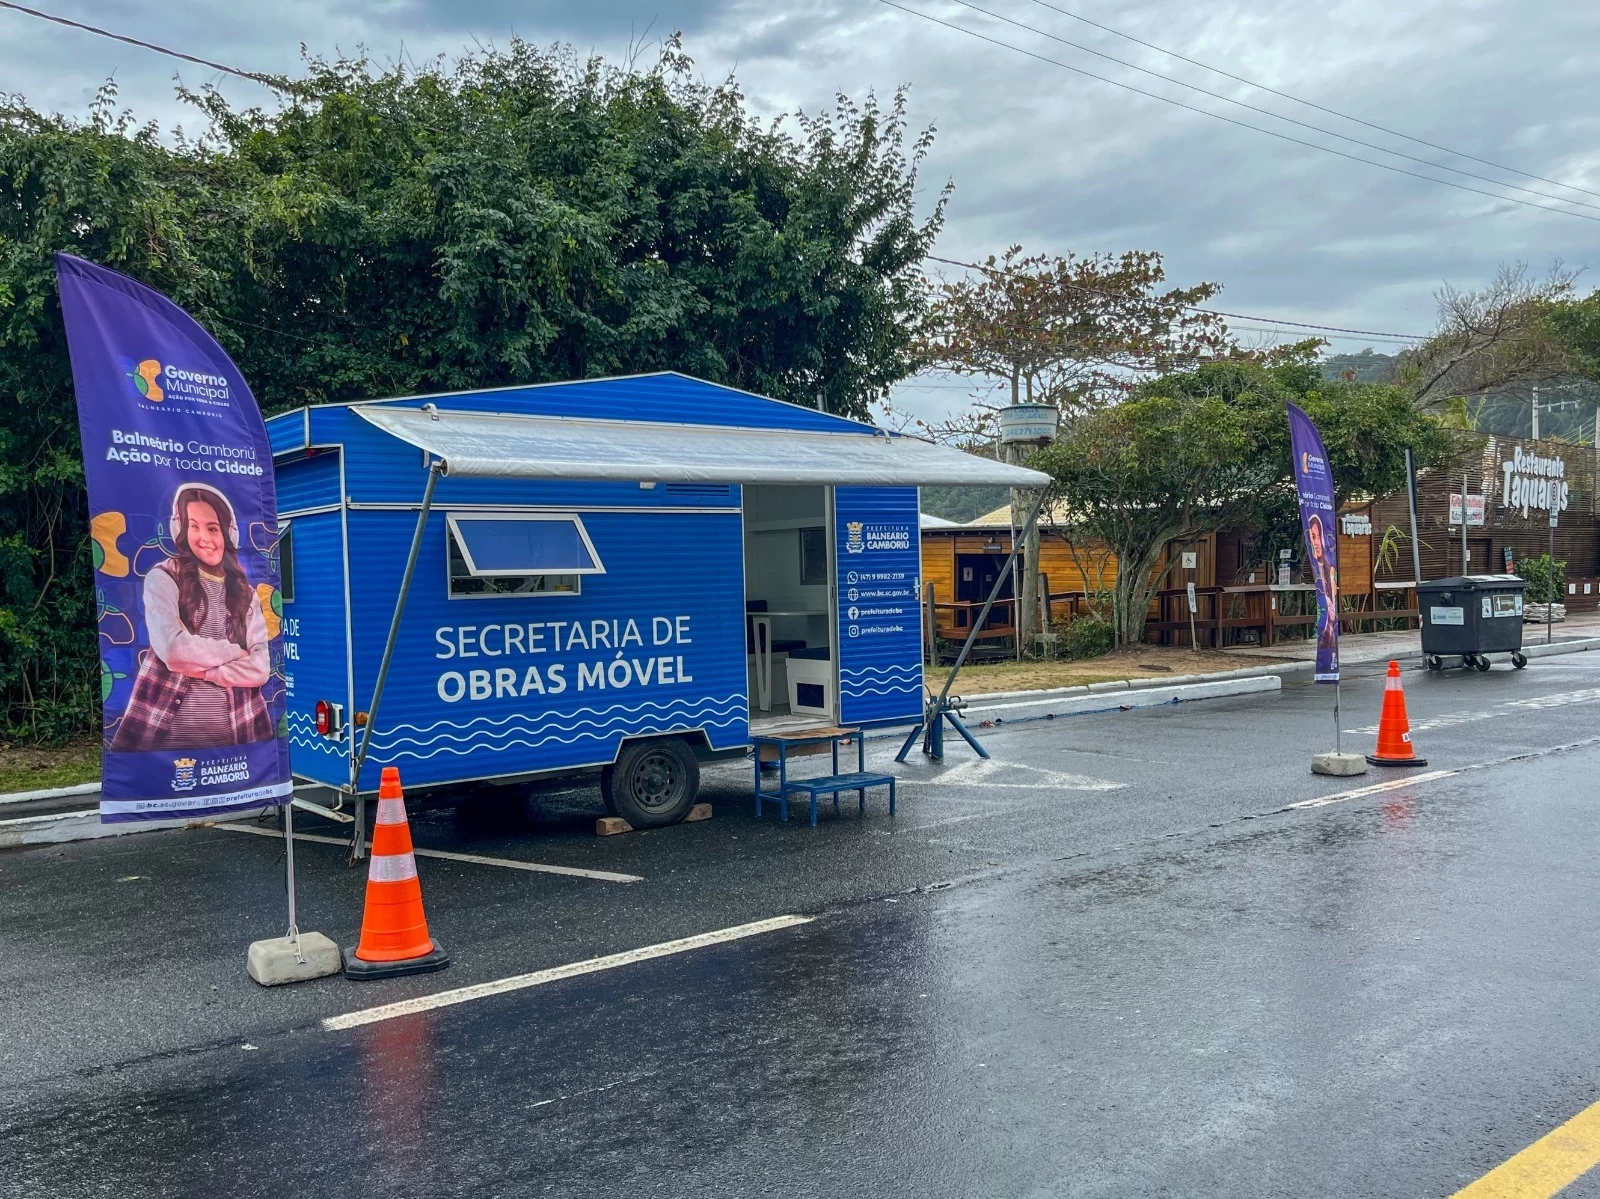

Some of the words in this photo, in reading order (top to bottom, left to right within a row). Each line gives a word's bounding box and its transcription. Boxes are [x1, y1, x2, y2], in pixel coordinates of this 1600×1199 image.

[165, 365, 227, 387] Governo
[166, 378, 229, 400] Municipal
[112, 429, 184, 453] Balneário
[187, 440, 256, 460] Camboriú
[106, 447, 151, 465] Ação
[153, 453, 171, 468] por
[175, 456, 212, 472] toda
[214, 459, 263, 476] Cidade
[1514, 446, 1564, 478] Restaurante
[866, 532, 909, 540] BALNEÁRIO
[866, 539, 909, 549] CAMBORIÚ
[860, 607, 903, 616] prefeituradebc
[289, 618, 300, 636] DE
[861, 625, 904, 634] prefeituradebc
[435, 617, 644, 659] SECRETARIA
[652, 615, 692, 645] DE
[437, 664, 567, 703] OBRAS
[577, 650, 693, 691] MÓVEL
[200, 761, 248, 776] BALNEÁRIO
[201, 755, 248, 766] PREFEITURA
[200, 770, 250, 786] CAMBORIÚ
